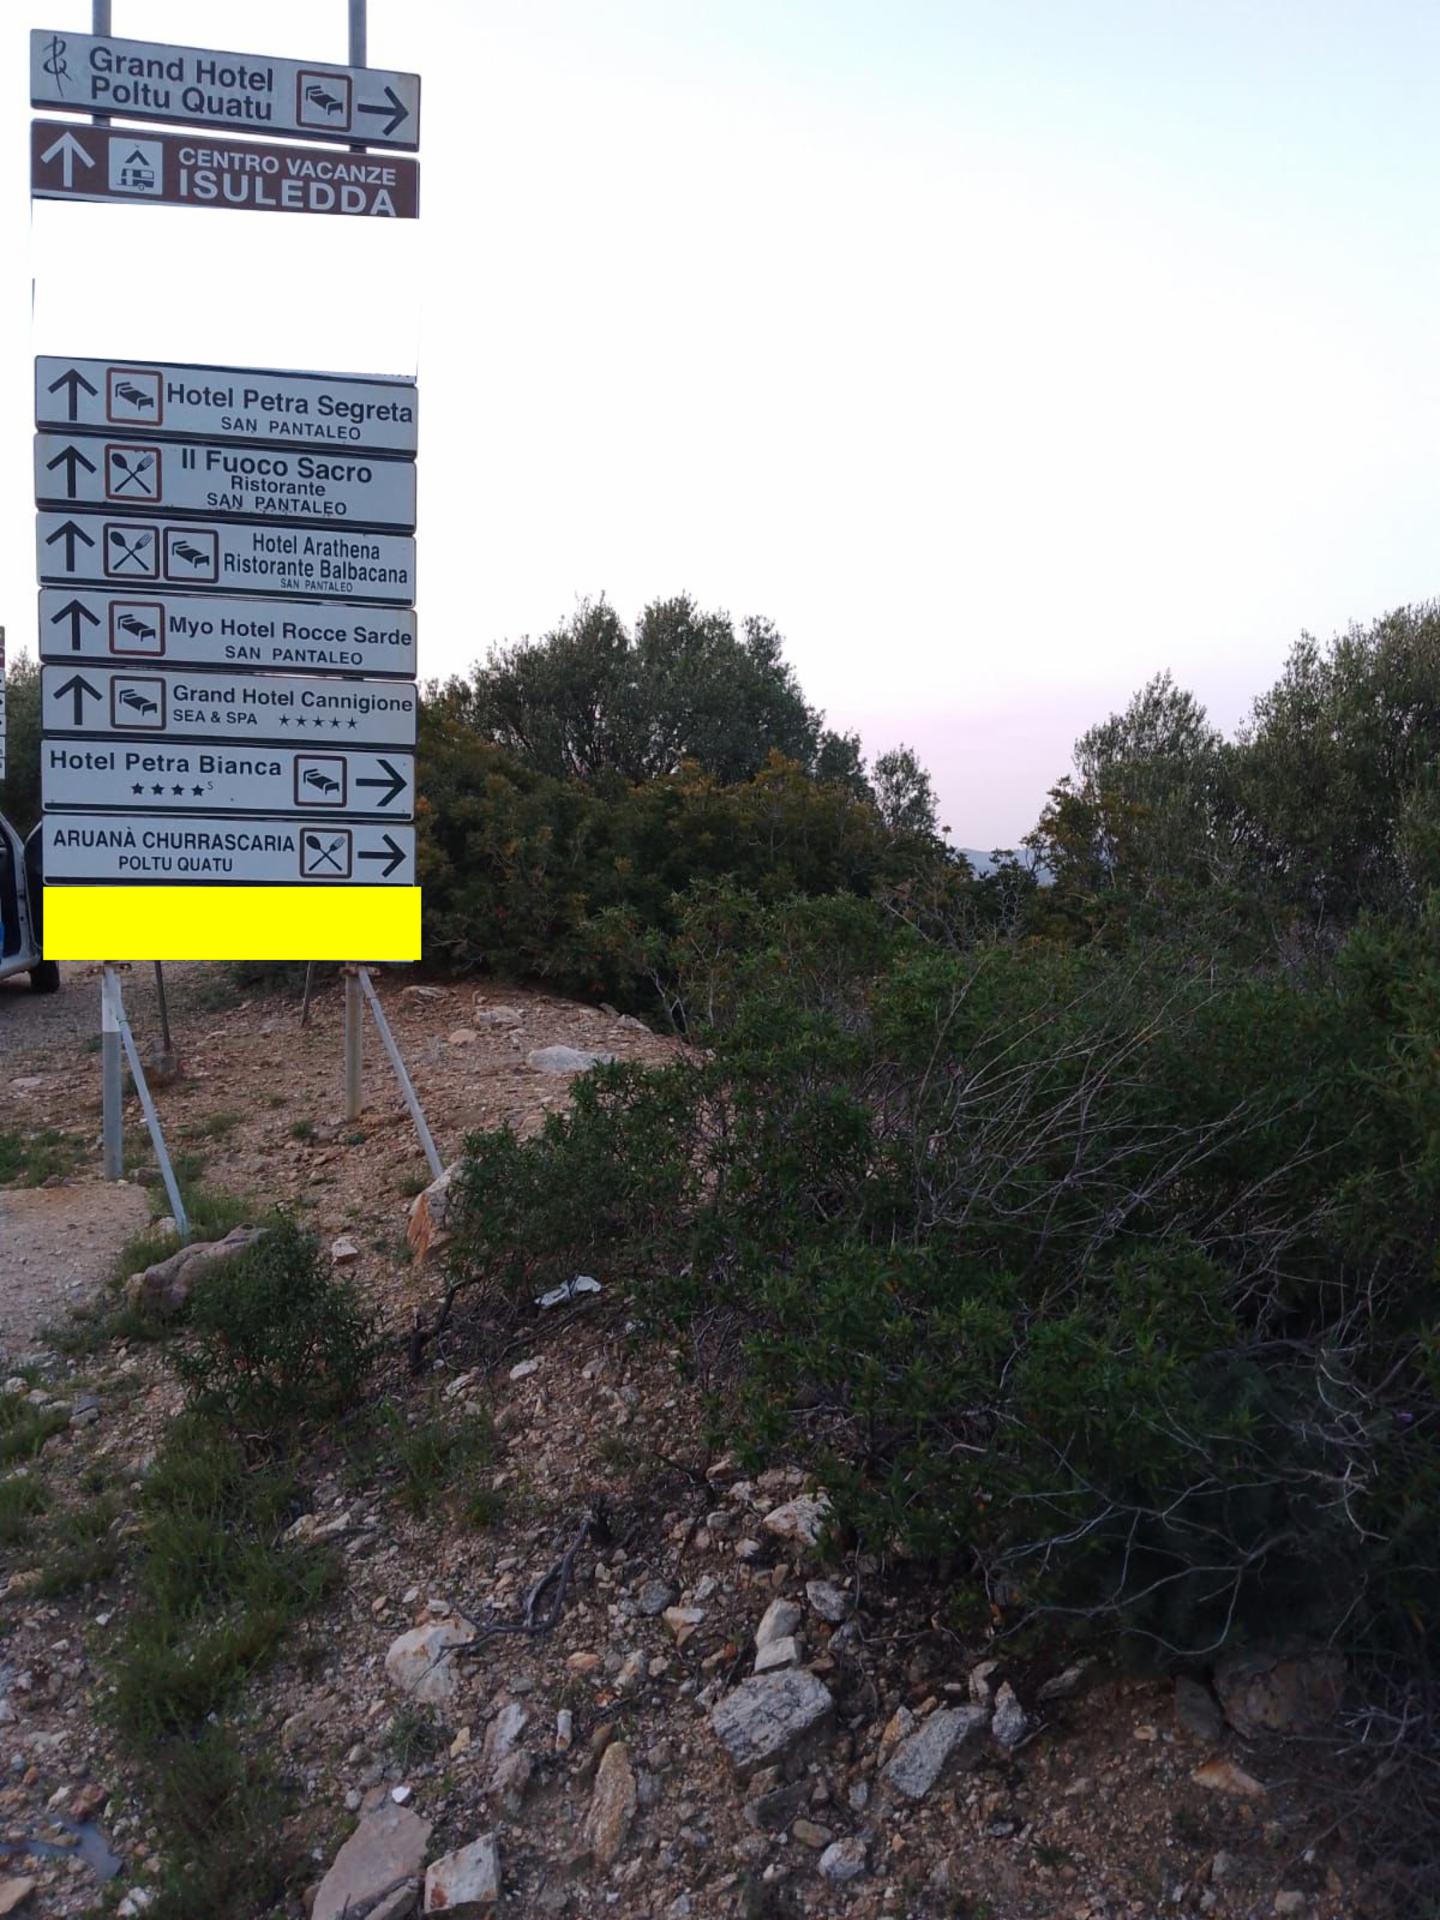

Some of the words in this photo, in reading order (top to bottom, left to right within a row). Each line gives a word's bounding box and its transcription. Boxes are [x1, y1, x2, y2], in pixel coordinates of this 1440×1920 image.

[89, 46, 184, 82] Grand
[196, 59, 273, 92] Hotel
[91, 75, 170, 109] Poltu
[182, 87, 272, 121] Quatu
[178, 147, 280, 174] CENTRO
[286, 157, 397, 186] VACANZE
[179, 168, 397, 217] ISULEDDA
[167, 382, 234, 408] Hotel
[243, 389, 309, 415] Petra
[317, 394, 413, 425] Segreta
[221, 416, 258, 432] SAN
[269, 420, 361, 441] PANTALEO
[182, 448, 196, 470] Il
[206, 450, 289, 477] Fuoco
[297, 456, 373, 484] Sacro
[231, 475, 326, 497] Ristorante
[207, 492, 243, 508] SAN
[255, 496, 347, 515] PANTALEO
[252, 533, 298, 554] Hotel
[303, 535, 380, 561] Arathena
[223, 553, 315, 578] Ristorante
[320, 560, 408, 585] Balbacana
[280, 578, 301, 590] SAN
[305, 579, 354, 593] PANTALEO
[169, 616, 214, 638] Myo
[220, 618, 275, 639] Hotel
[282, 622, 347, 644] Rocce
[353, 627, 412, 647] Sarde
[225, 645, 261, 661] SAN
[272, 648, 363, 666] PANTALEO
[173, 684, 236, 704] Grand
[242, 687, 295, 707] Hotel
[301, 691, 413, 715] Cannigione
[173, 709, 206, 723] SEA
[210, 710, 221, 724] &
[226, 711, 258, 726] SPA
[50, 750, 115, 771] Hotel
[125, 753, 190, 773] Petra
[199, 755, 282, 776] Bianca
[53, 826, 136, 848] ARUANÀ
[142, 831, 295, 852] CHURRASCARIA
[119, 855, 173, 871] POLTU
[177, 856, 233, 873] QUATU
